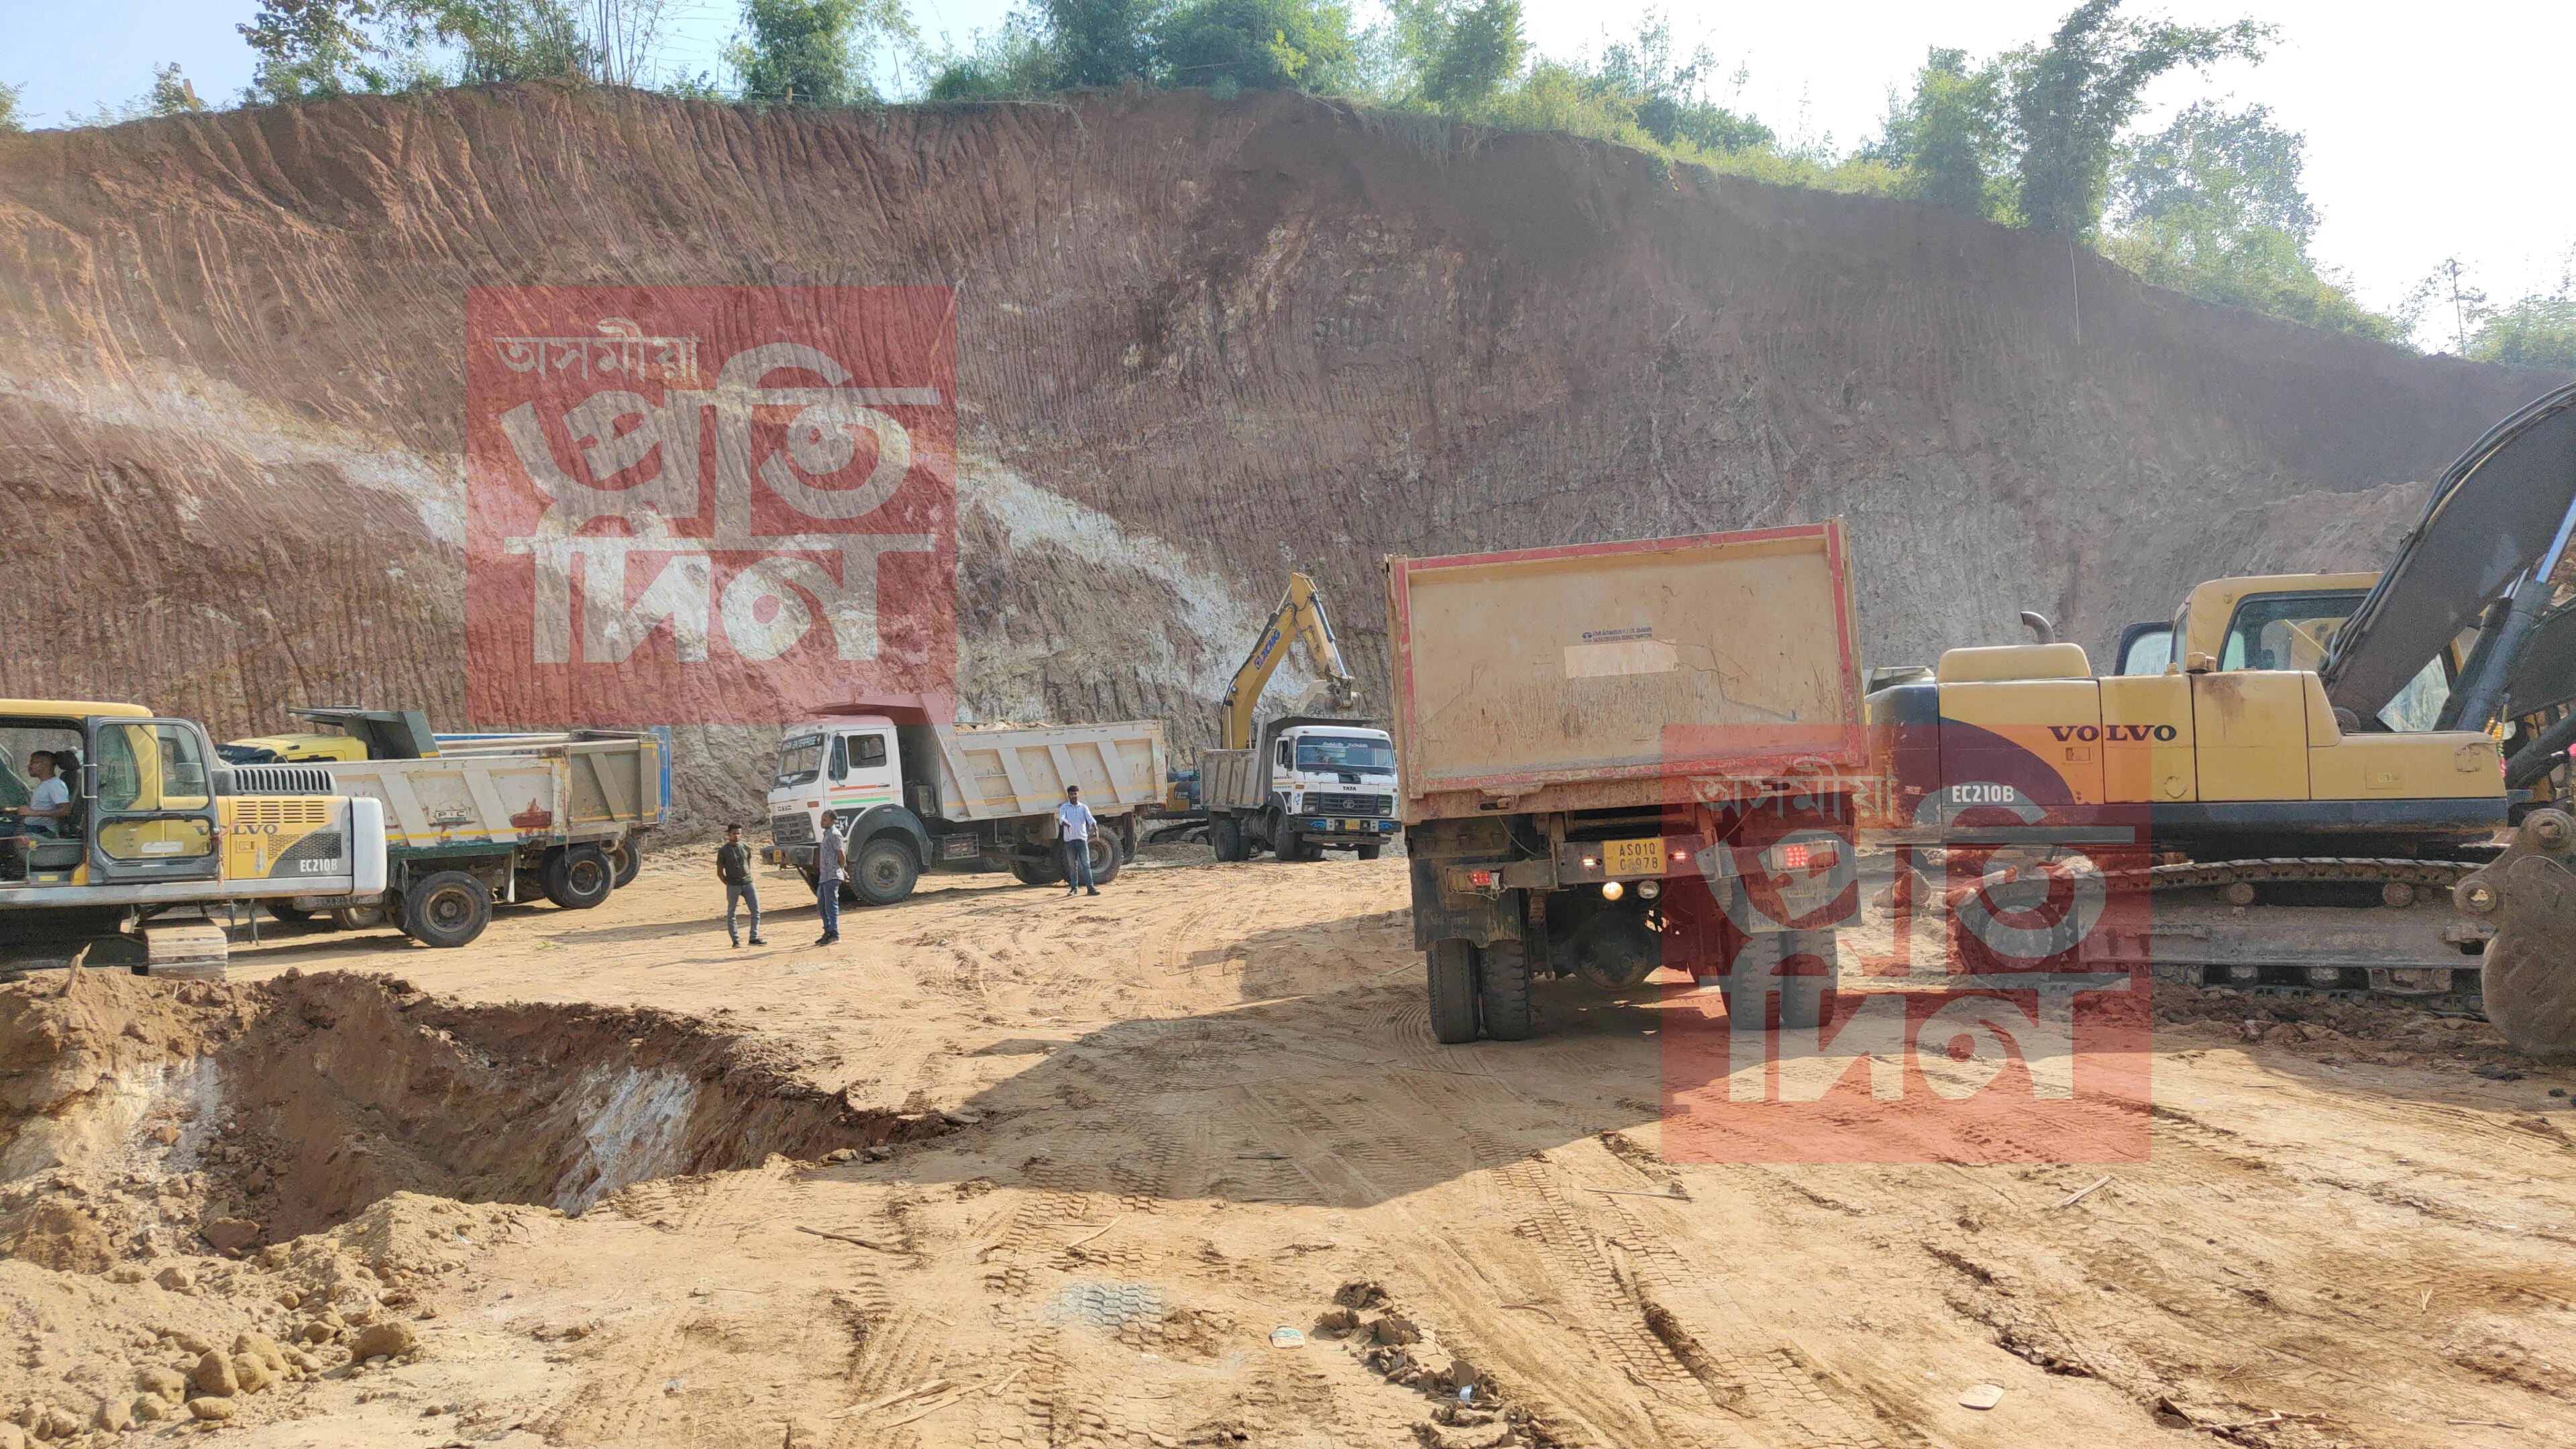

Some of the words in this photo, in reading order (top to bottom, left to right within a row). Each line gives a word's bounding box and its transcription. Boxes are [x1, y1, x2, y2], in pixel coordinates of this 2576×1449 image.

[1260, 629, 1281, 661] XCMG
[2047, 724, 2178, 742] VOLVO
[1951, 785, 2015, 803] EC210B
[193, 824, 278, 835] VLVO
[300, 859, 338, 872] EC210B
